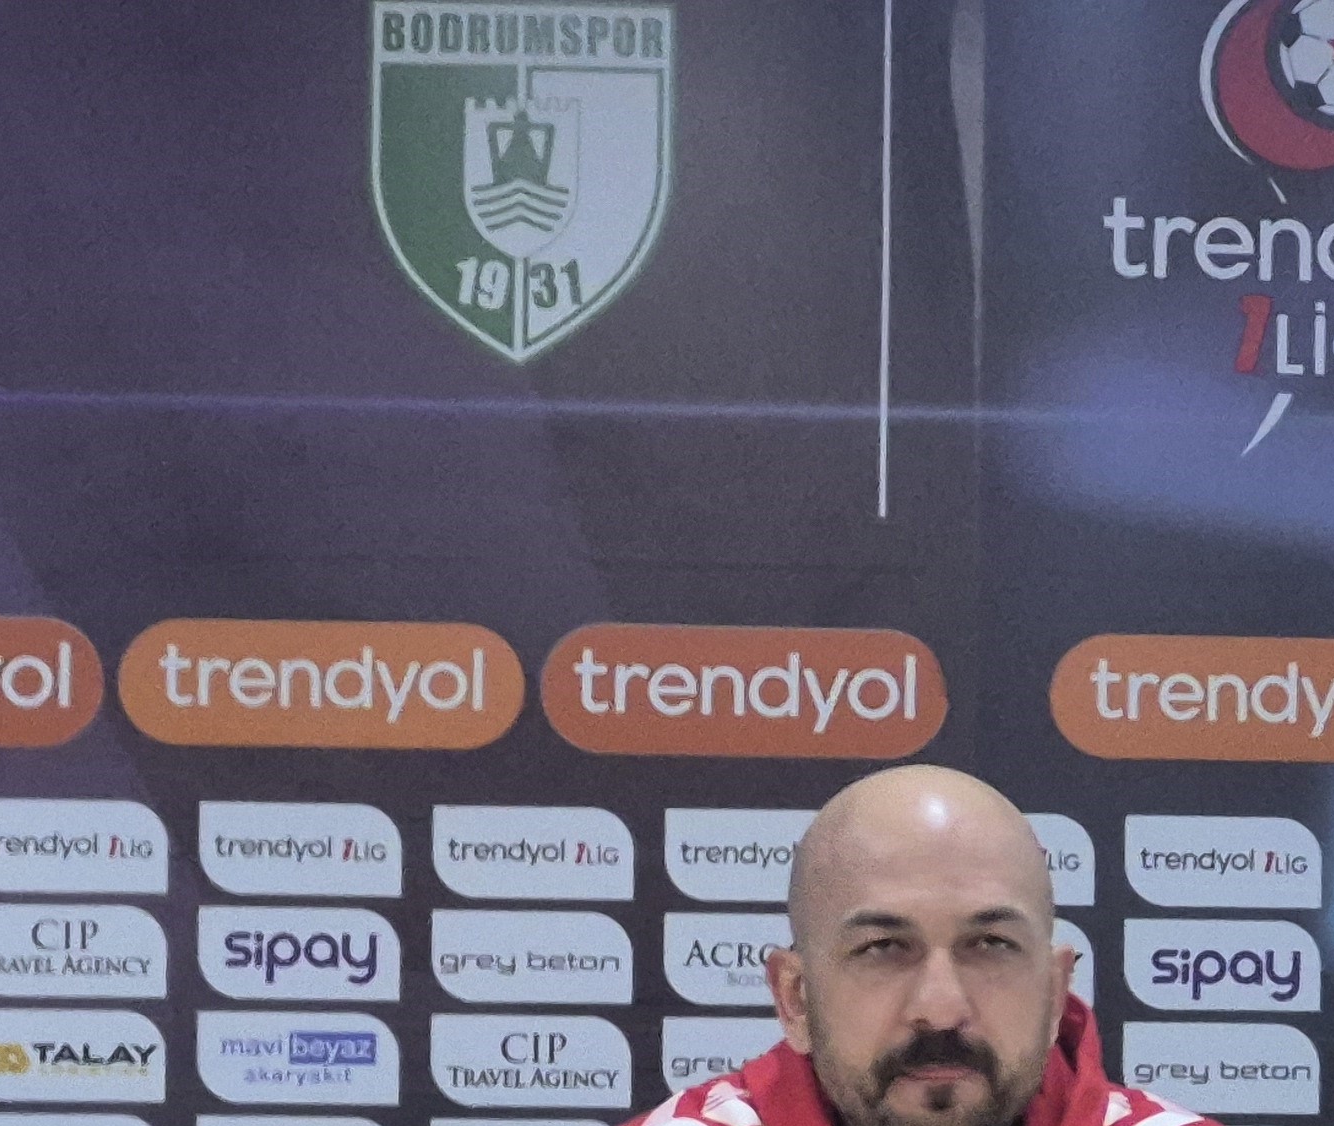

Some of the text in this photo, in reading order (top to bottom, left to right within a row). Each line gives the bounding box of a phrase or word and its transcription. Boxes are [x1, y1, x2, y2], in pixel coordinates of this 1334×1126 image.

[381, 12, 664, 58] BODRUMSPOR
[159, 644, 485, 723] trendyol
[574, 648, 917, 733] trendyol
[215, 835, 332, 862] trendyol
[448, 838, 565, 866] trendyol
[1140, 848, 1255, 875] trendyol
[31, 920, 98, 950] CIP
[62, 953, 150, 976] AGENCY
[225, 931, 377, 985] sipay
[440, 954, 516, 975] grey
[1152, 949, 1301, 1002] sipay
[33, 1043, 157, 1067] TALAY
[501, 1033, 567, 1064] CIP
[447, 1066, 618, 1089] TRAVEL AGENCY
[1134, 1061, 1311, 1085] grey beton
